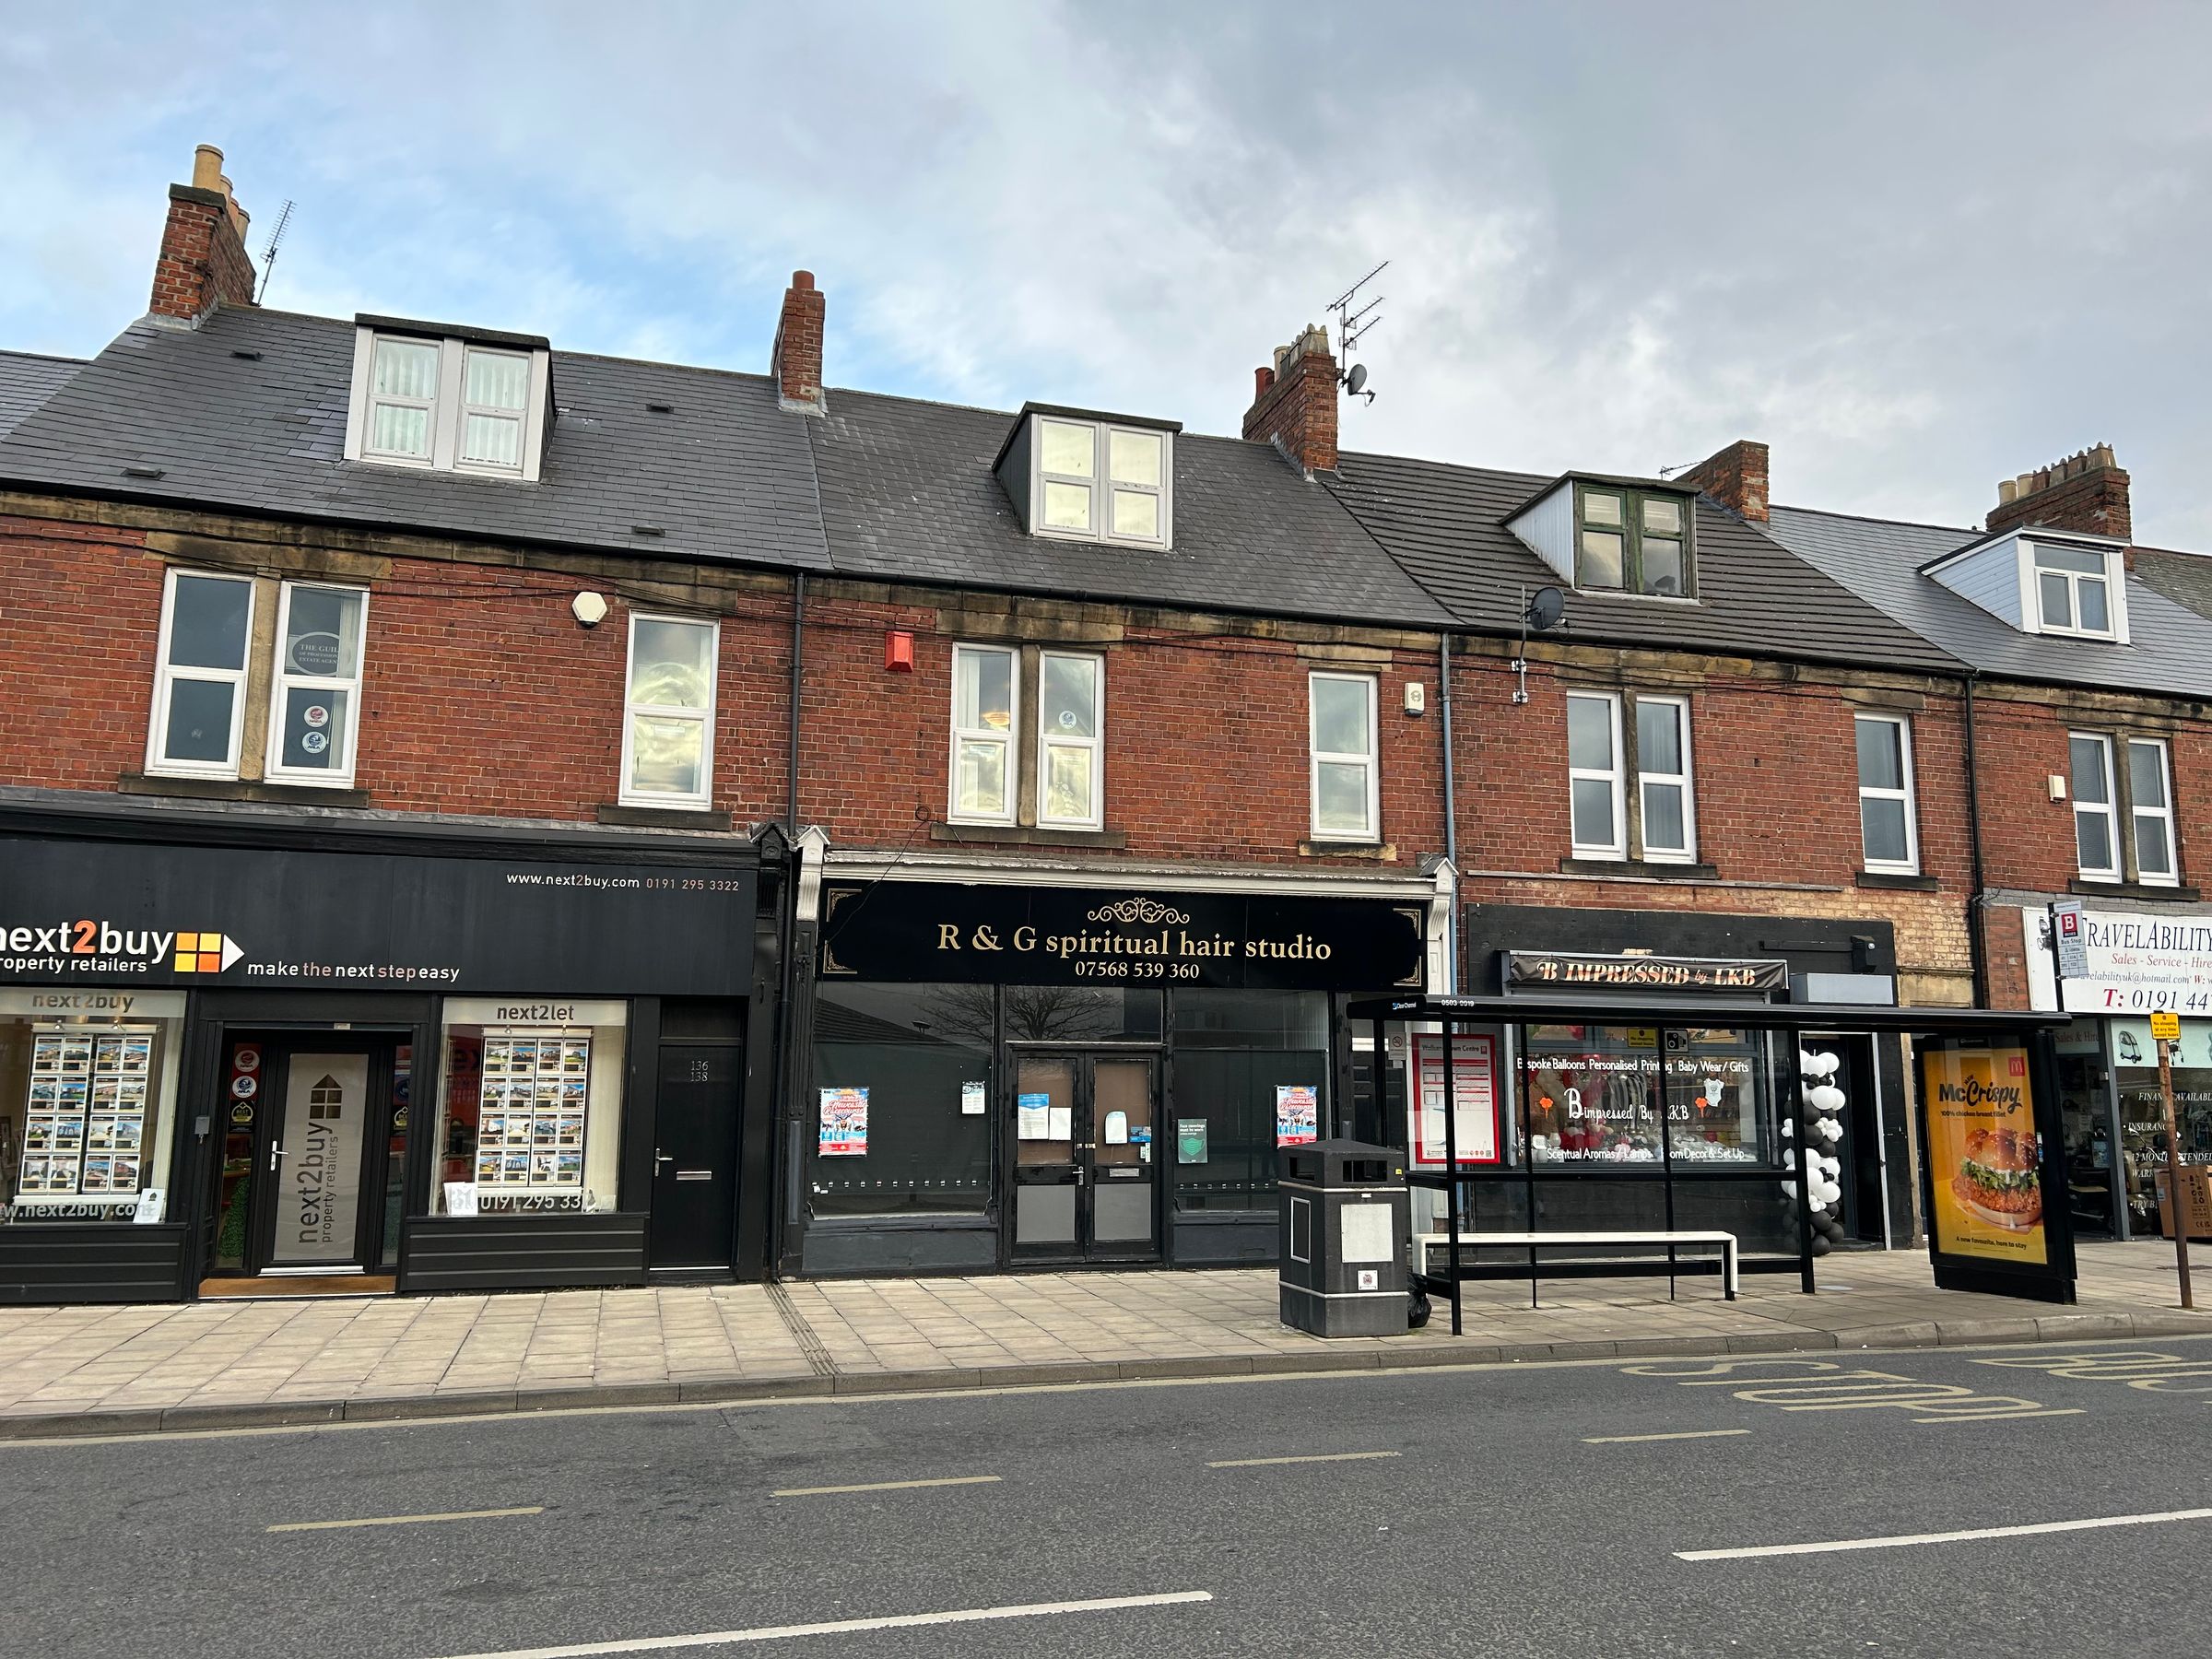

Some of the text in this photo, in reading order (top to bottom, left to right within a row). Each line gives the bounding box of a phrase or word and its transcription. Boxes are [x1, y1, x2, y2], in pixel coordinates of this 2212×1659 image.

[507, 874, 739, 891] www.next2buy.com 0191 295 3322
[2064, 915, 2075, 929] B
[937, 924, 1332, 959] R & G spiritual hair studio
[2082, 918, 2212, 951] RAVELABILITY
[0, 956, 147, 974] operty retailers
[2112, 953, 2137, 965] Sales
[2147, 955, 2182, 968] Service
[2191, 957, 2212, 969] Hire
[247, 961, 460, 982] make the next step easy
[1075, 961, 1200, 979] 07568 539 360
[1565, 963, 1689, 983] IMPRESSED
[1694, 969, 1709, 984] by
[1713, 968, 1756, 985] LKB
[2088, 971, 2191, 984] elabilityuk@hotmail.com
[32, 993, 135, 1013] next2buy
[2103, 989, 2212, 1010] T: 0191 44
[497, 1006, 574, 1020] next2let
[691, 1061, 708, 1070] 136
[1517, 1057, 1553, 1071] Bspoke
[1553, 1058, 1585, 1069] Balloons
[1589, 1058, 1637, 1070] Personalised
[1678, 1060, 1698, 1074] Baby
[1730, 1062, 1748, 1073] Gifts
[690, 1072, 708, 1081] 138
[2138, 1092, 2212, 1101] FINAN AVAILABL
[1639, 1105, 1653, 1123] By
[1547, 1148, 1582, 1159] Scentual
[1583, 1148, 1615, 1159] Aromas
[1685, 1148, 1705, 1159] Decor
[1717, 1149, 1732, 1159] Set
[1734, 1149, 1745, 1162] Up
[296, 1122, 333, 1243] next2buy
[322, 1136, 338, 1242] property retailers
[480, 1194, 581, 1210] 0191 295 33
